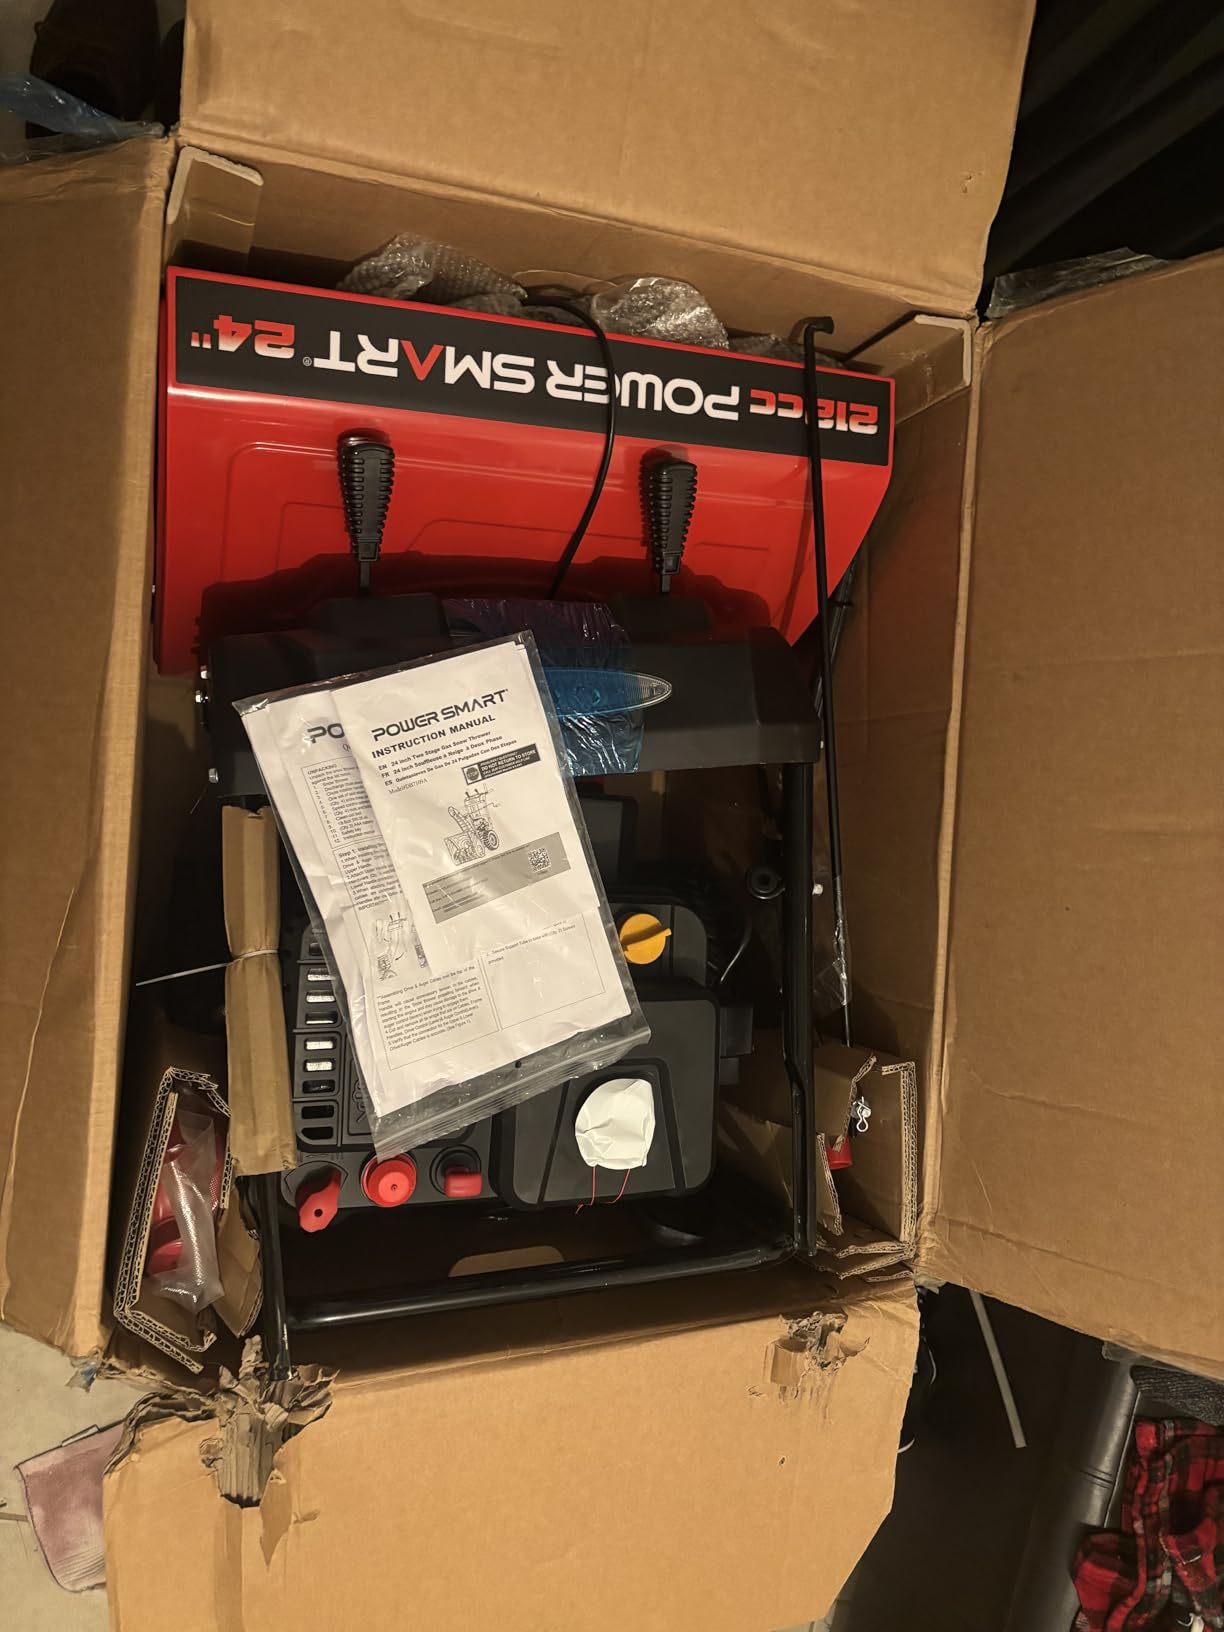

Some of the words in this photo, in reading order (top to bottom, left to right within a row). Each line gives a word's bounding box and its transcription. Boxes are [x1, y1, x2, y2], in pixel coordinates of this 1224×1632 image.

[190, 314, 295, 359] 24"
[545, 359, 740, 421] POWER
[371, 710, 440, 742] POWER
[441, 689, 506, 721] SMART
[371, 729, 447, 759] INSTRUCTION
[449, 714, 496, 734] MANUAL
[412, 752, 424, 760] Two
[425, 747, 440, 756] Stage
[452, 738, 468, 746] Snow
[468, 731, 491, 741] Thrower
